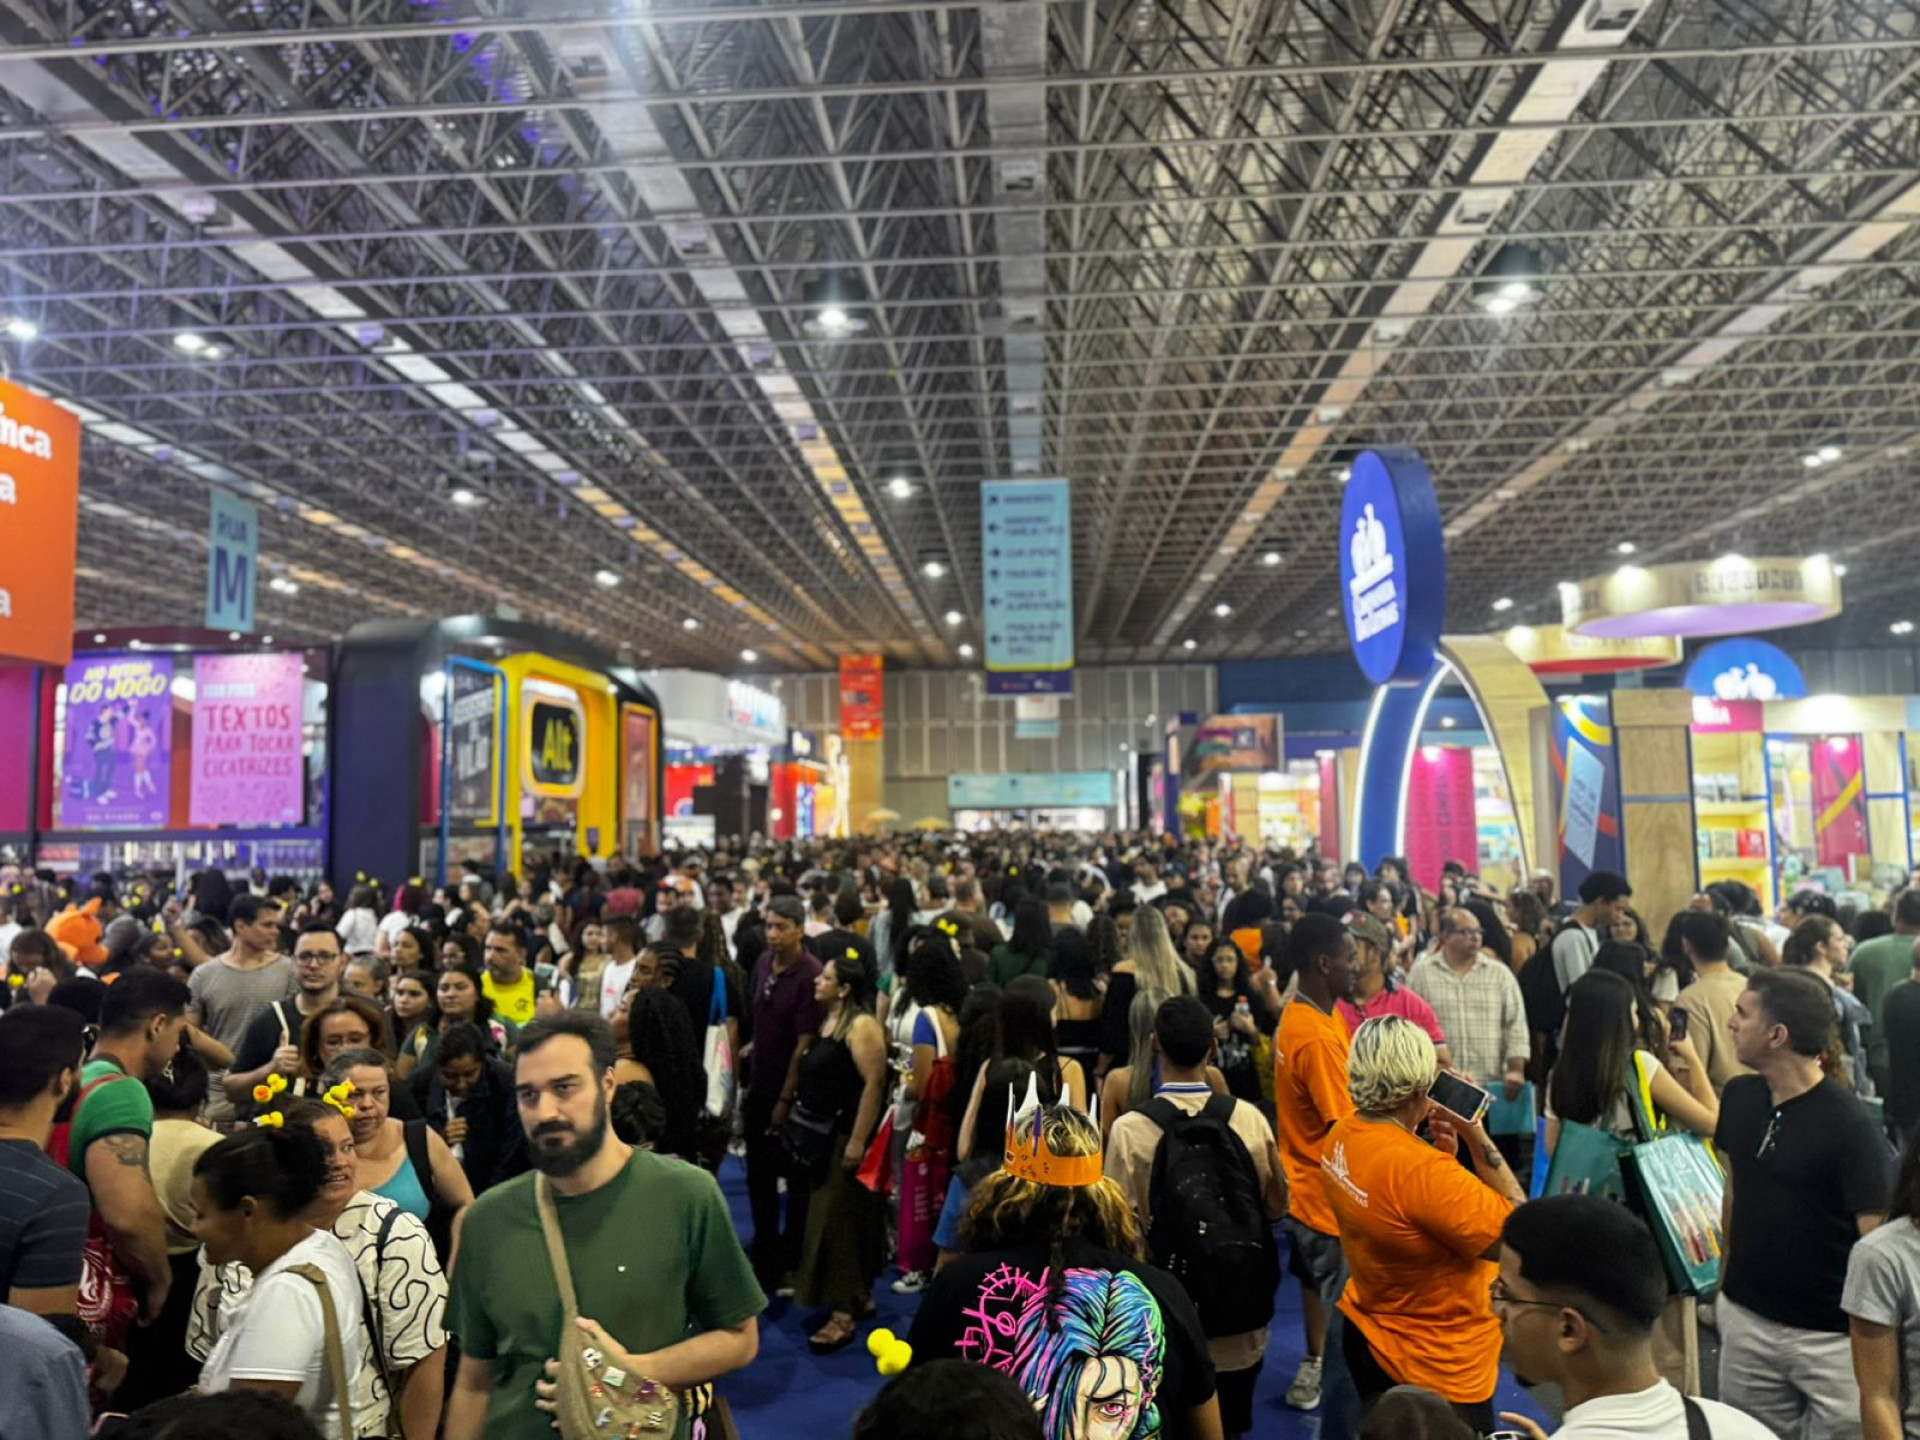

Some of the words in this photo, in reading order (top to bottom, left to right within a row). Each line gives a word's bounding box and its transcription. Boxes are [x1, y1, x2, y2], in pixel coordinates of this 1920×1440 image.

[217, 511, 248, 543] RUA
[213, 546, 248, 621] M
[105, 673, 167, 700] JOGO
[203, 704, 291, 733] TEXTOS
[204, 733, 242, 754] PARA
[250, 733, 294, 753] TOCAR
[203, 755, 293, 779] CICATRIZES
